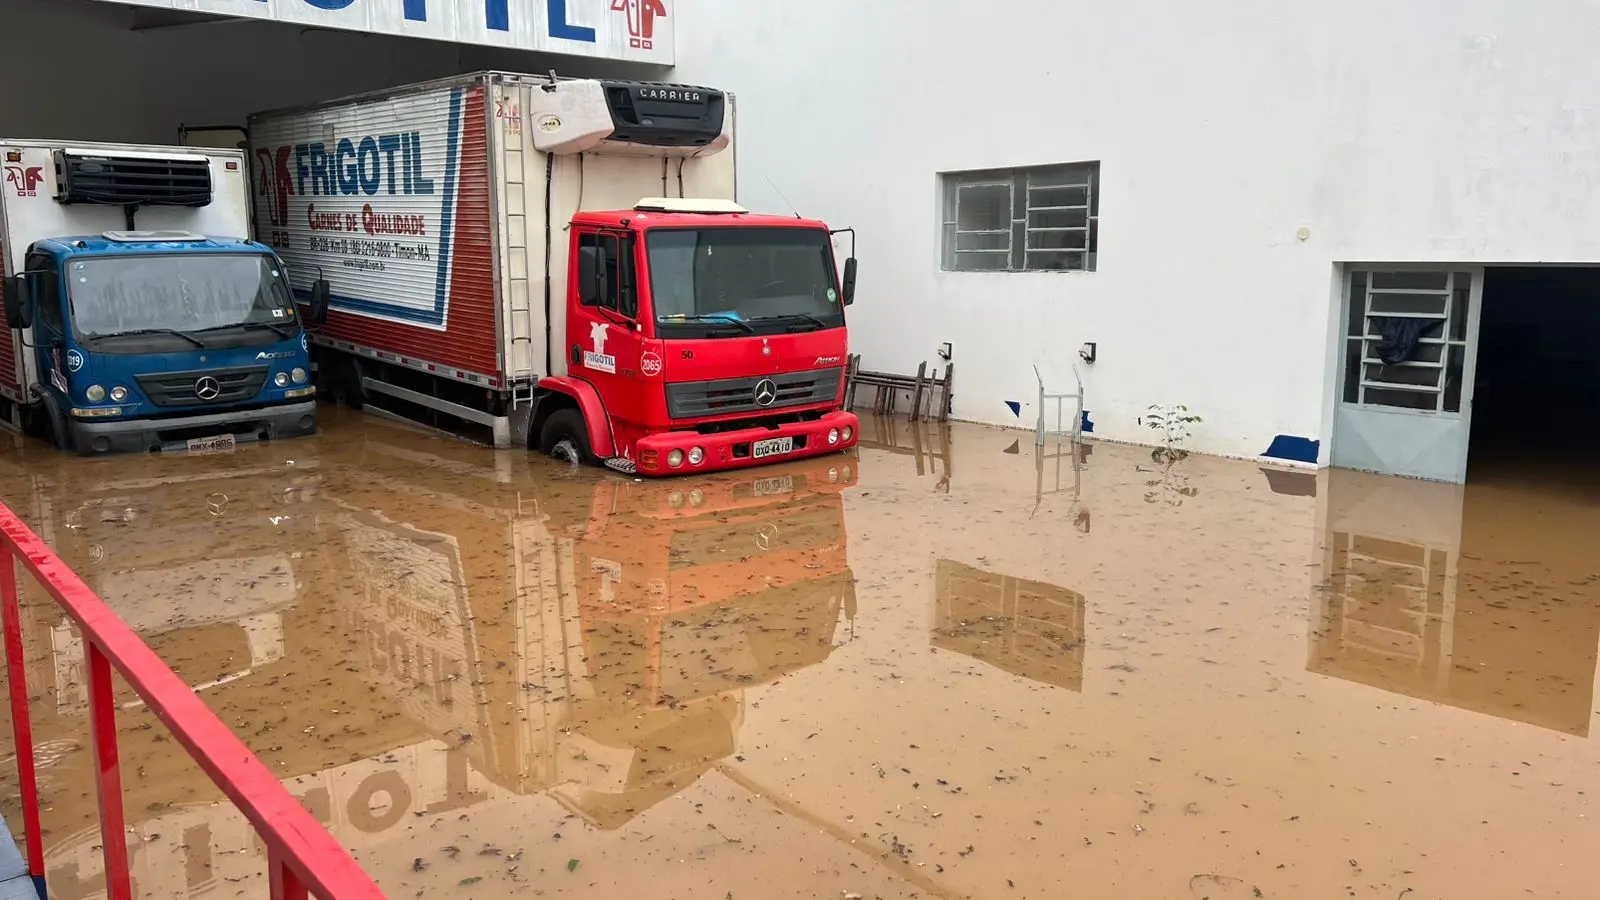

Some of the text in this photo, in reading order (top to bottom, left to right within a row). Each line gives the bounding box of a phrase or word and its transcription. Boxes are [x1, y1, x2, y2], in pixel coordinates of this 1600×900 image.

[639, 88, 700, 101] CARRIER
[295, 131, 435, 196] FRIGOTIL
[361, 202, 426, 236] QUALIDADE
[584, 351, 615, 367] FRIGOTIL
[681, 350, 694, 360] 50
[642, 358, 661, 372] 2065
